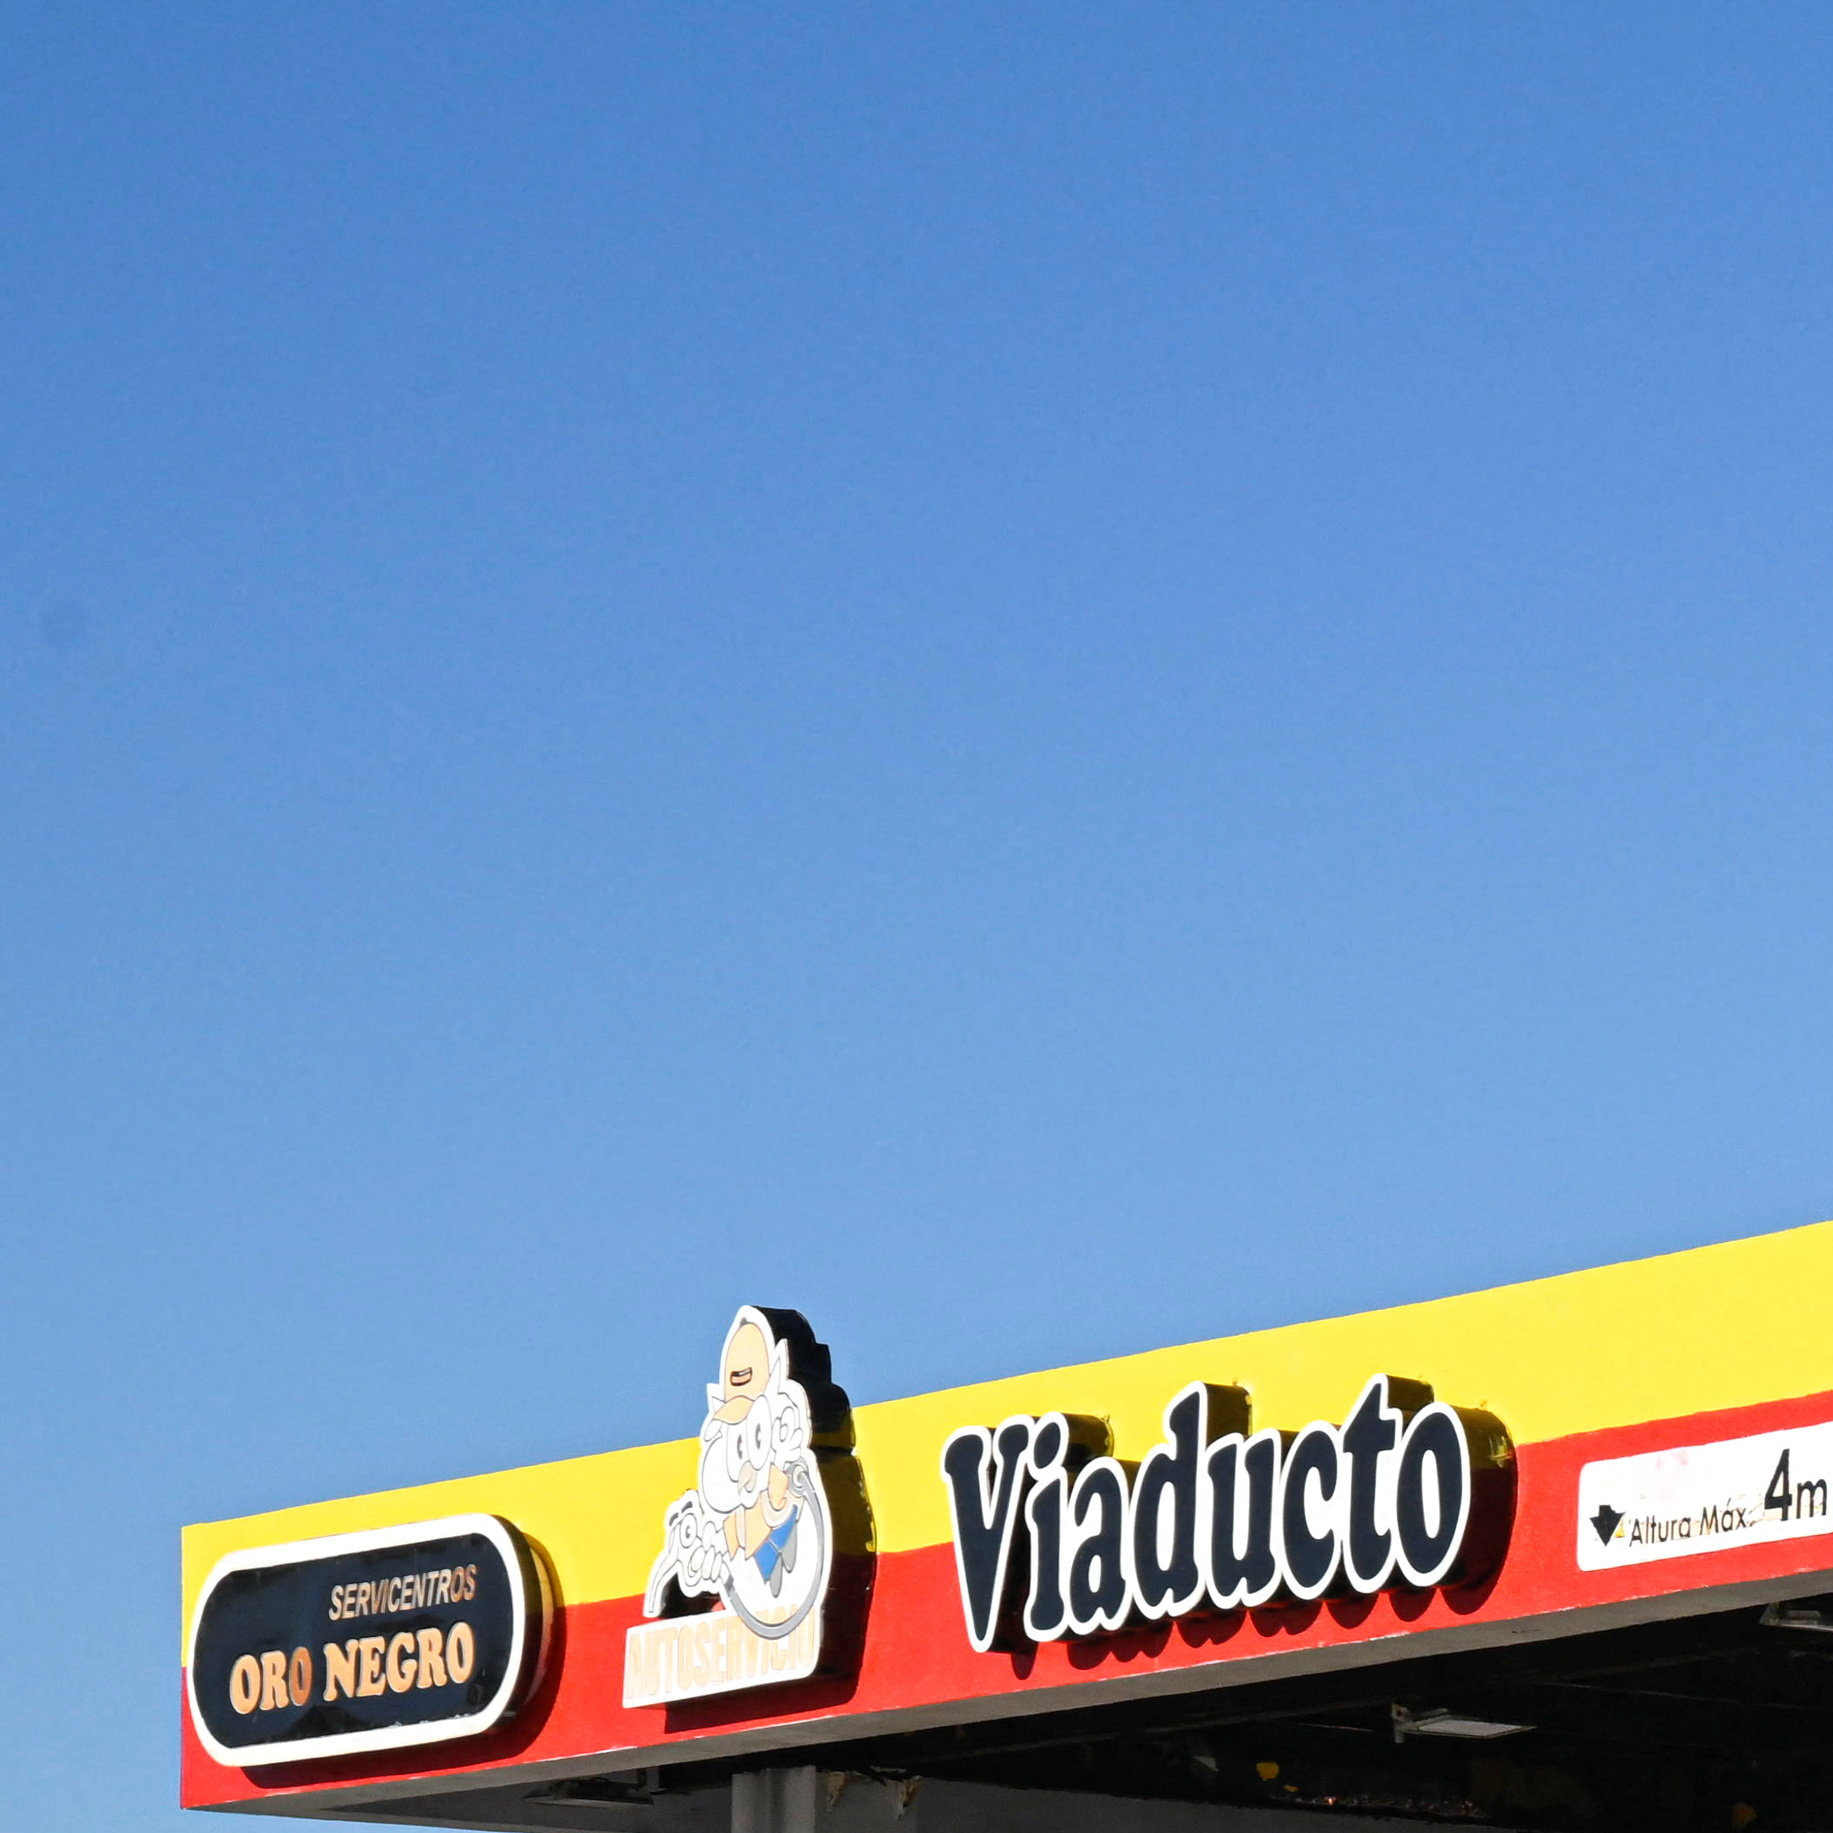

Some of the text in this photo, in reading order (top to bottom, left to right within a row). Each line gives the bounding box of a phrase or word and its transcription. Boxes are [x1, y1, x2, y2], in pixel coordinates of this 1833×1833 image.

[941, 1373, 1470, 1653] Viaducto
[1629, 1517, 1691, 1547] Altura
[328, 1563, 477, 1622] SERVICENTROS
[229, 1621, 475, 1715] ORO NEGRO
